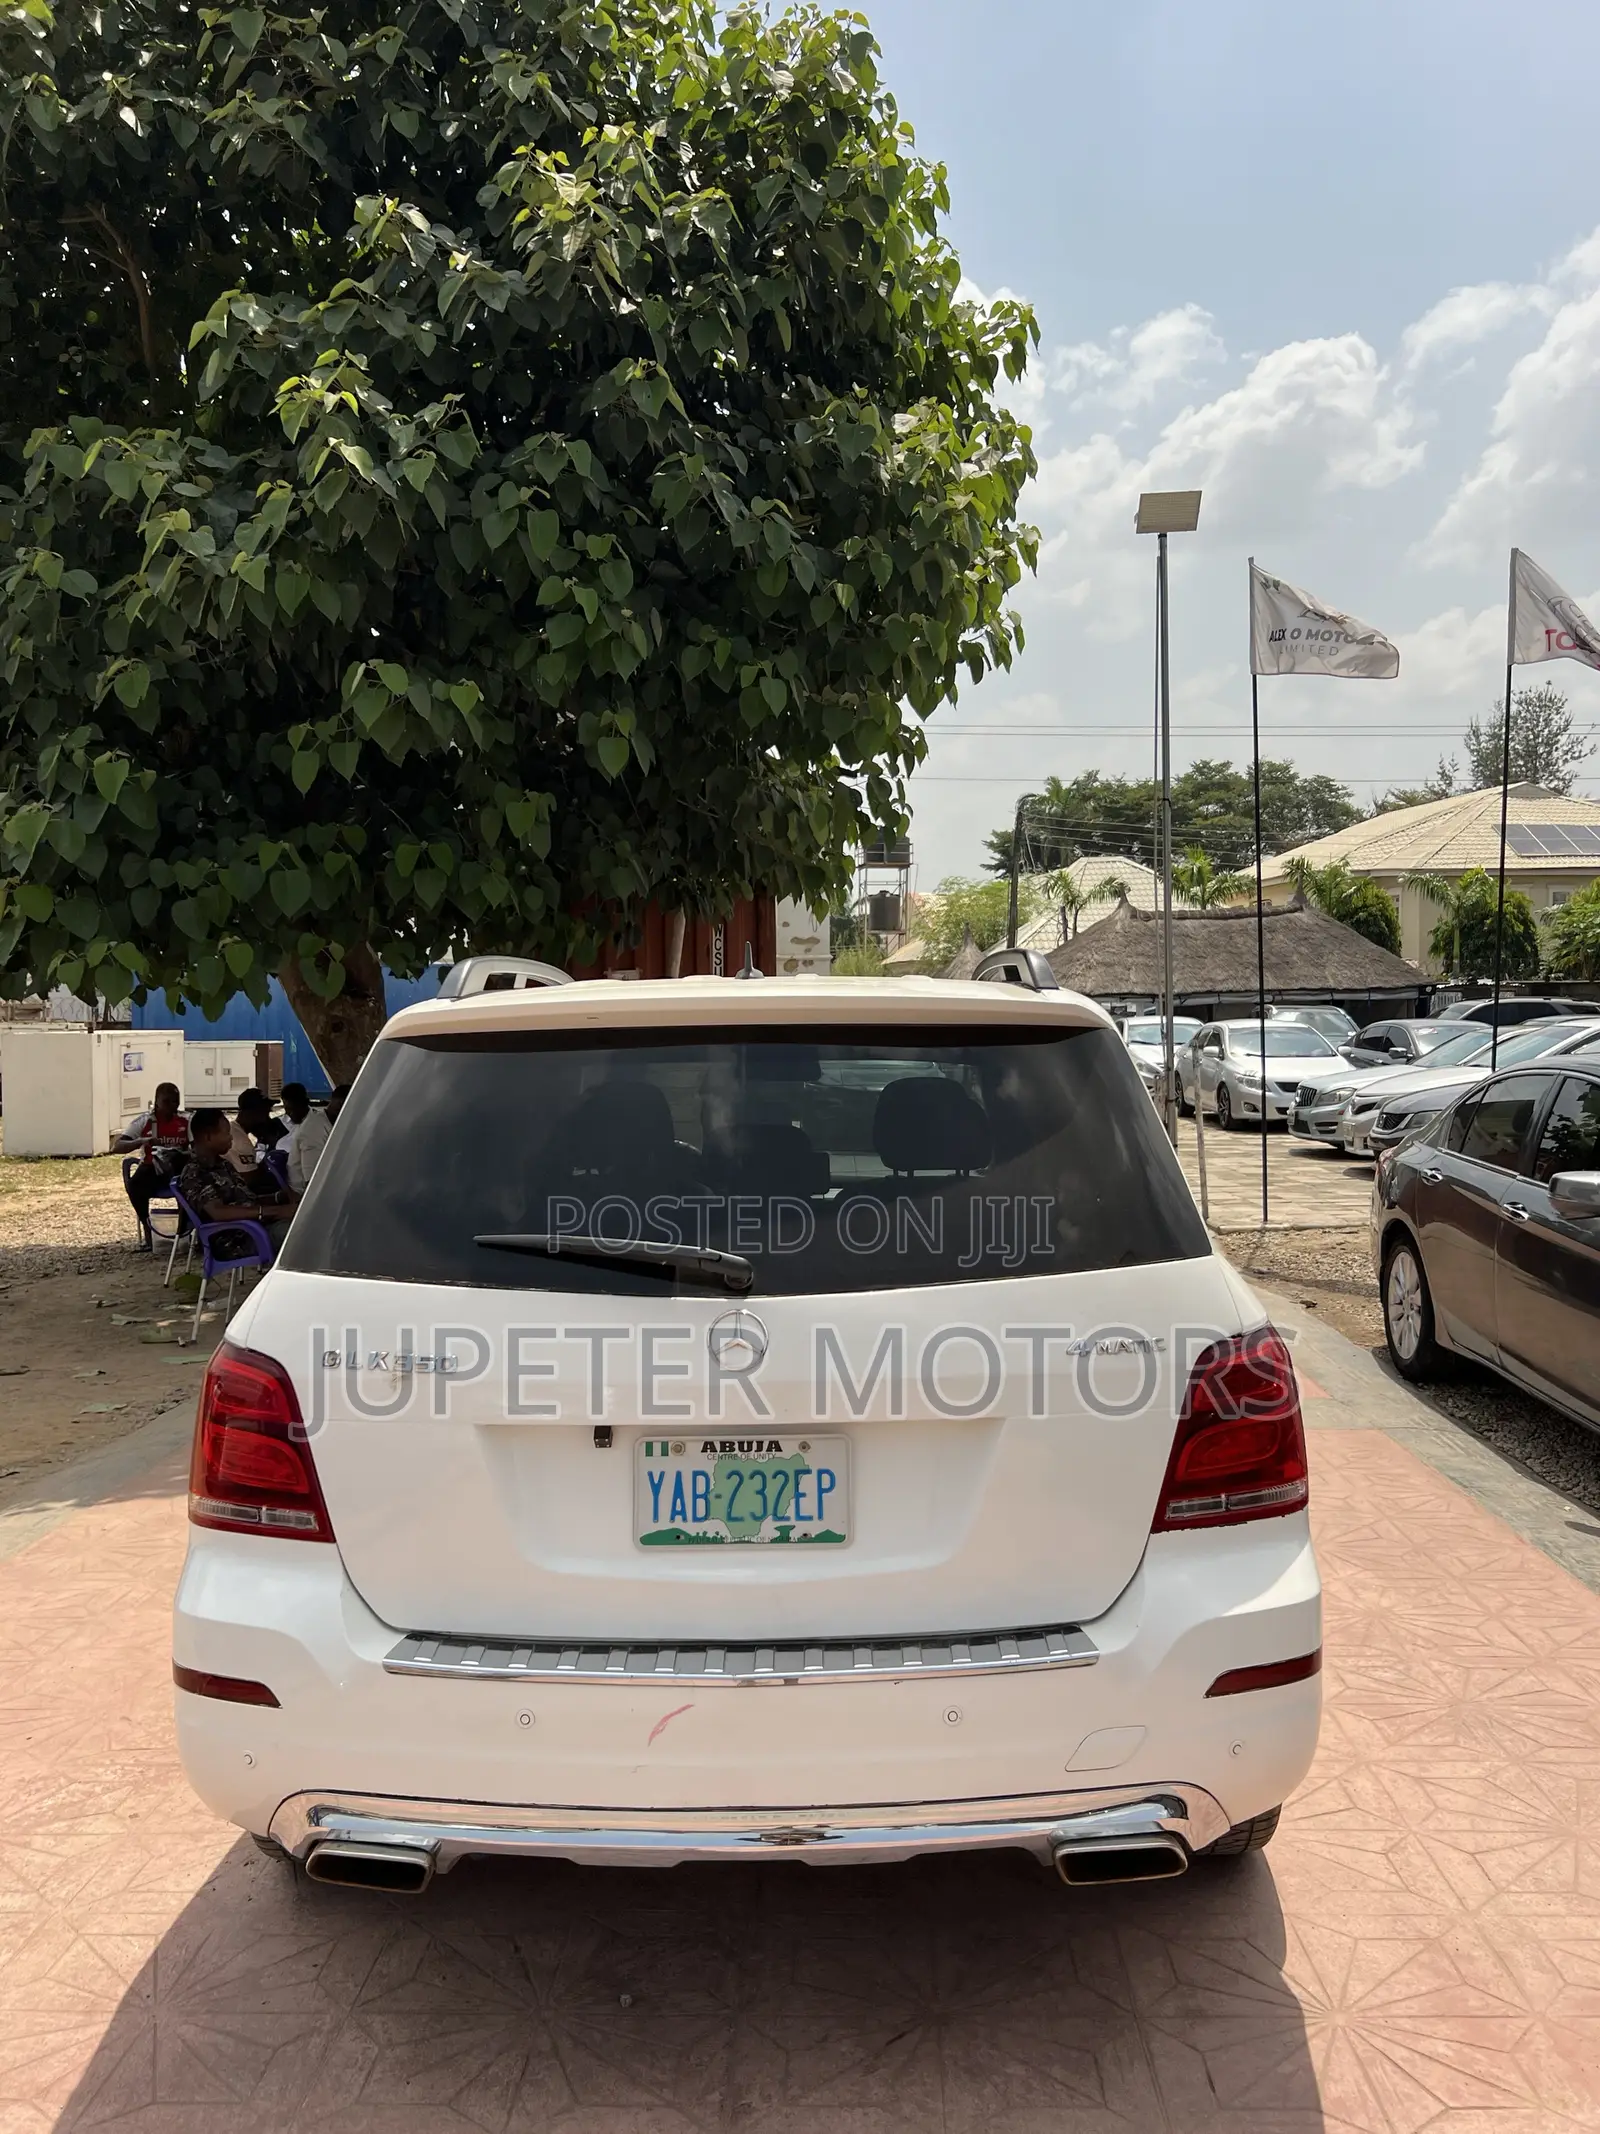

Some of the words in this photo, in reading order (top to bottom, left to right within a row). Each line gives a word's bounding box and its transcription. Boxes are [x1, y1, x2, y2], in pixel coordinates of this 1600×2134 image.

[1290, 628, 1302, 641] O
[1280, 642, 1339, 656] LIMITED
[701, 1440, 783, 1453] ABUJA
[707, 1453, 738, 1461] CENTRE
[740, 1453, 751, 1461] OF
